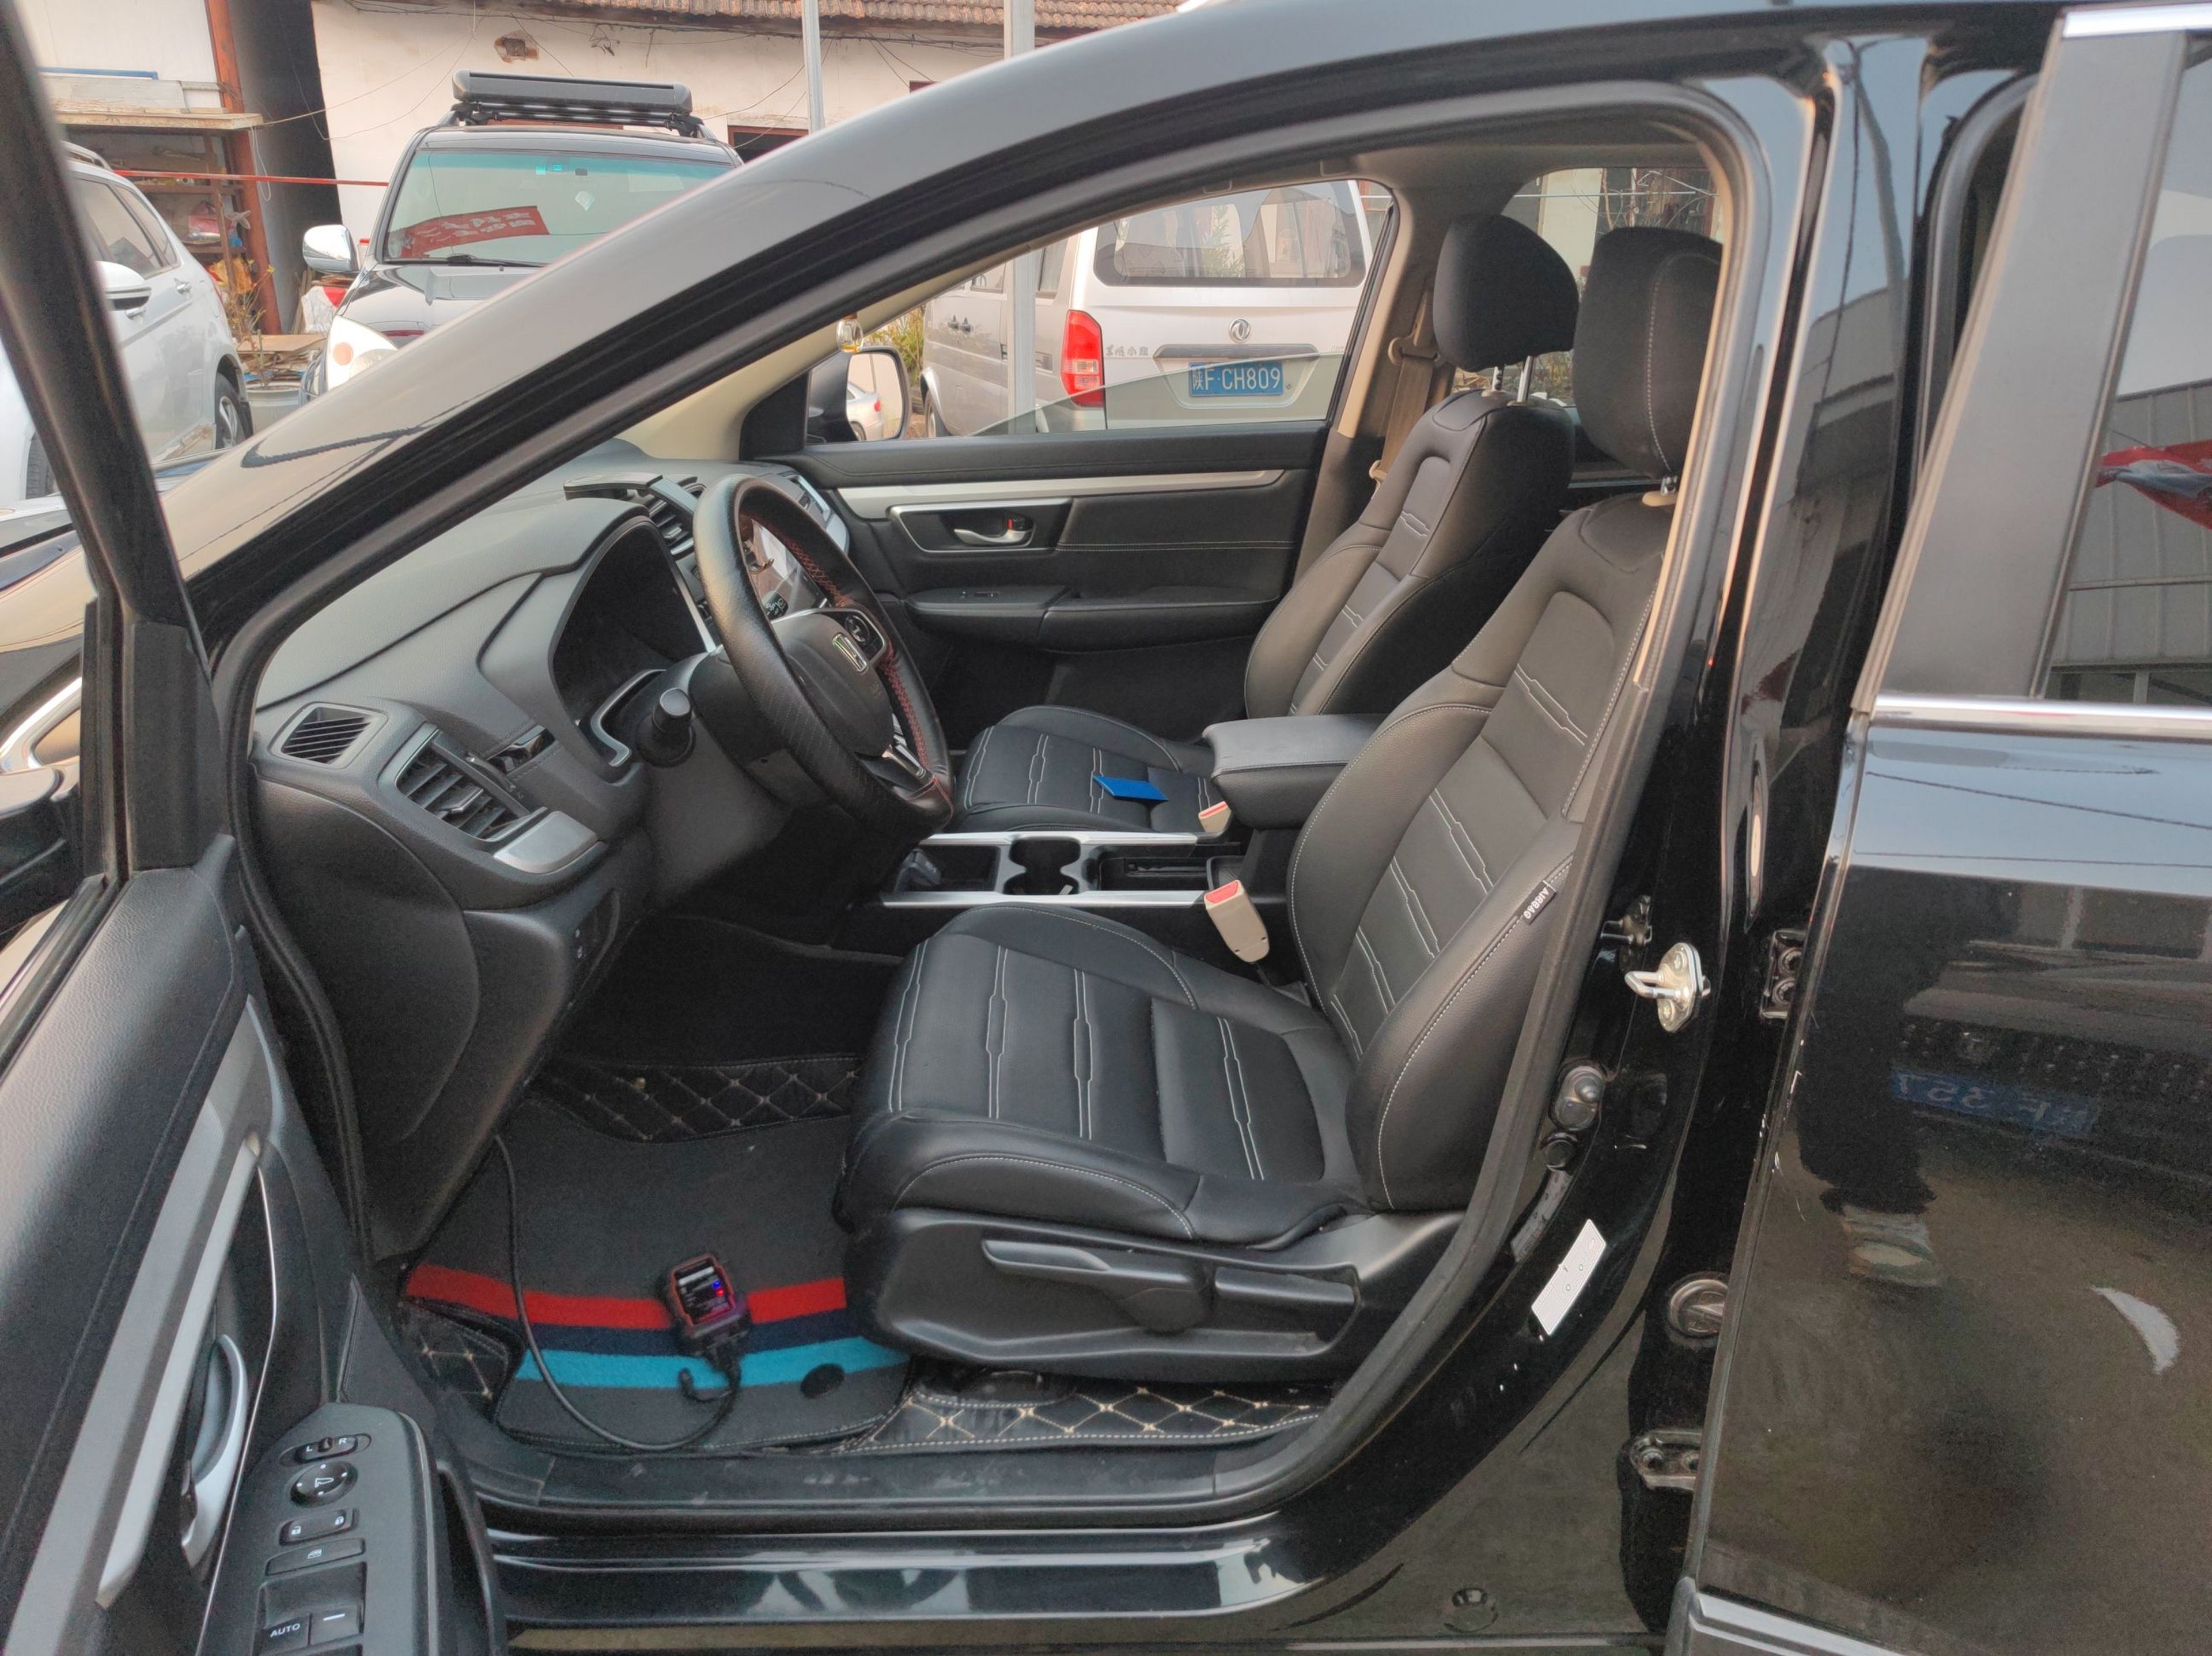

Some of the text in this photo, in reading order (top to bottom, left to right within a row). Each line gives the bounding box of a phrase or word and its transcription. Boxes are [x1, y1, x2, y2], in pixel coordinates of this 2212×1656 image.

[1524, 887, 1549, 919] AIRBAG
[339, 1437, 347, 1445] R
[270, 1623, 301, 1638] AUTO
